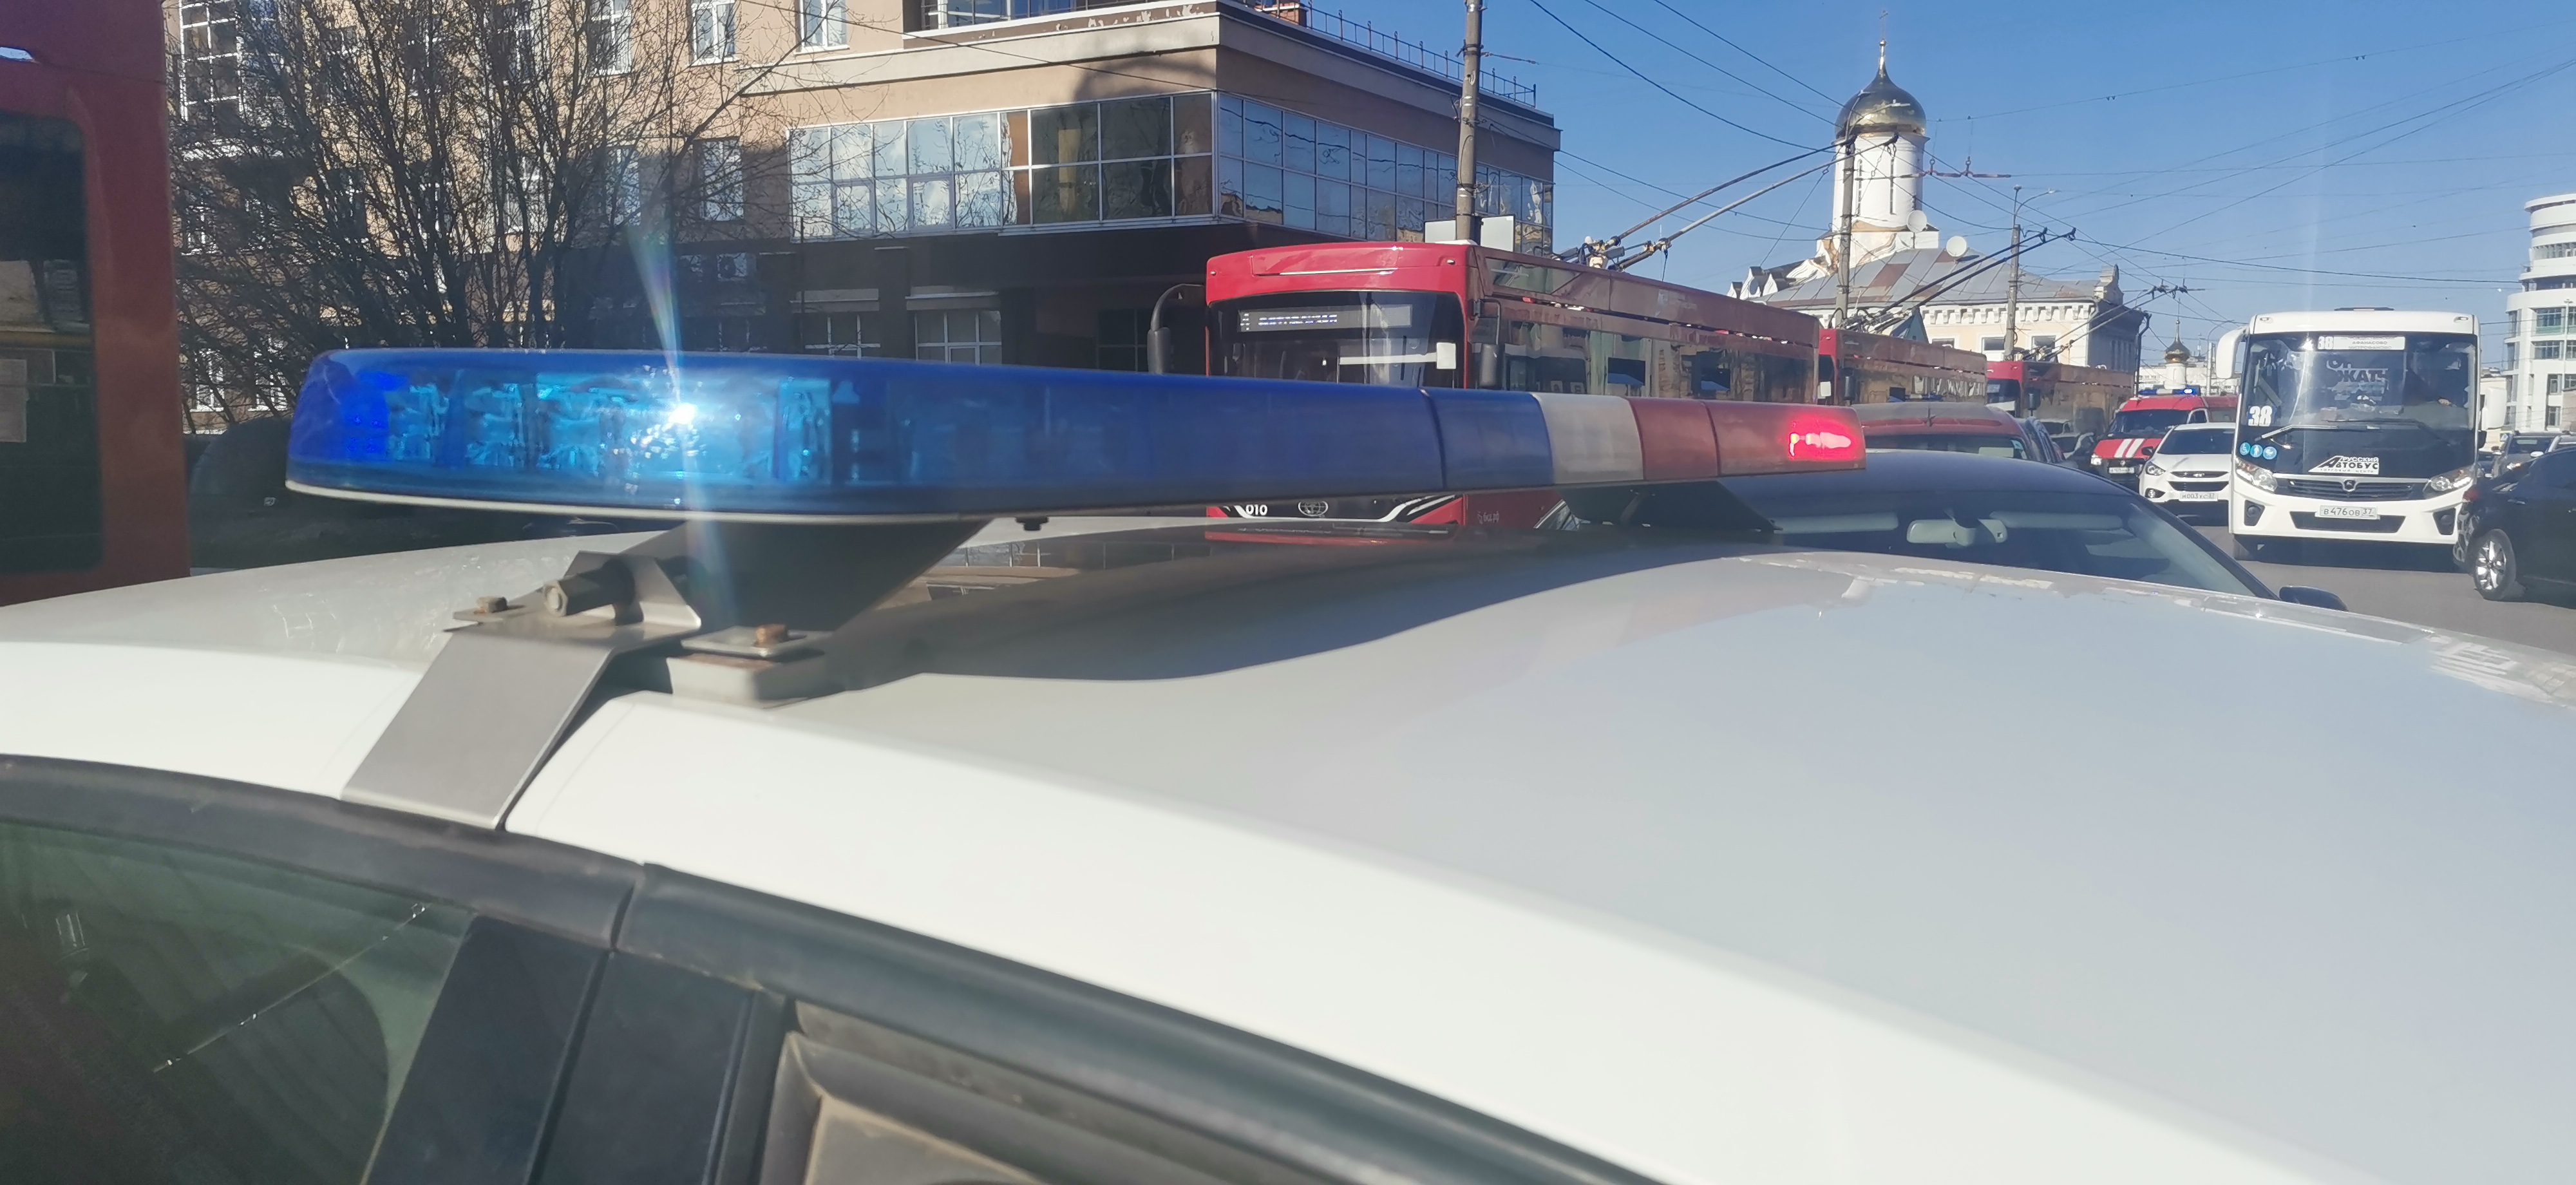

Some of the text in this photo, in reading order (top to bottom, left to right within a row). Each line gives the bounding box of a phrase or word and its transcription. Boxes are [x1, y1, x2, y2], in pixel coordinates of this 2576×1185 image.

[2318, 336, 2334, 349] 38
[2248, 406, 2273, 426] 38
[1245, 504, 1268, 515] 010
